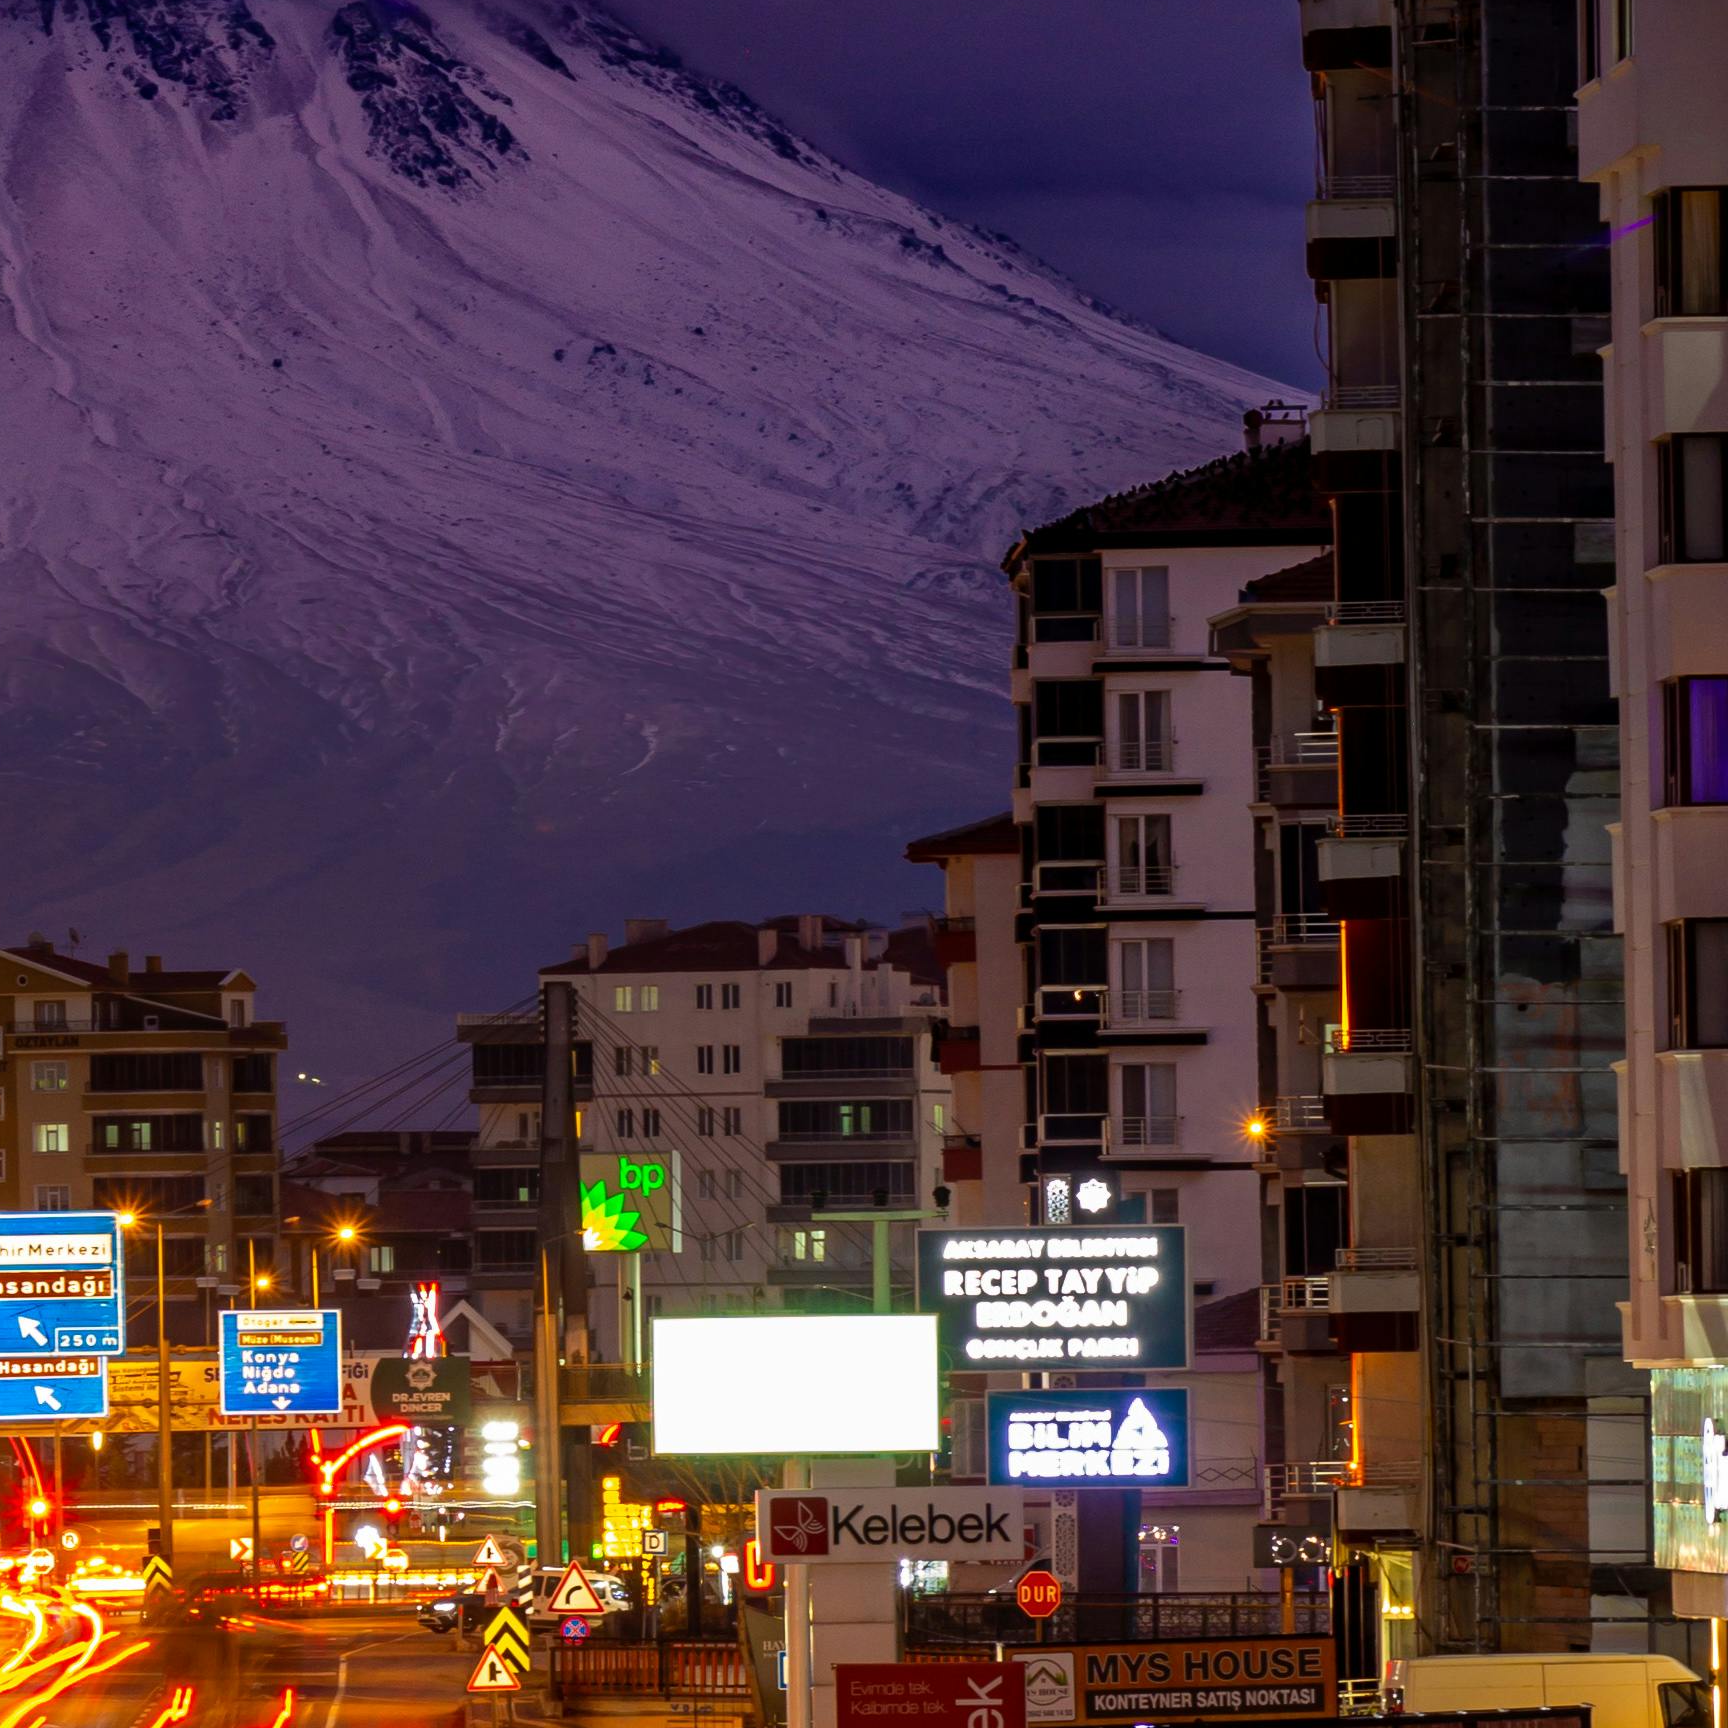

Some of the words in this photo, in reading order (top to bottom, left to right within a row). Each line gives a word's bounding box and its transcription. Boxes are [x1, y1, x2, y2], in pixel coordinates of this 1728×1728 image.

[618, 1156, 665, 1198] bp
[28, 1243, 107, 1257] Merkezi
[944, 1269, 1039, 1297] RECEP
[976, 1296, 1128, 1328] ERDOĞAN
[60, 1334, 97, 1347] 250
[101, 1335, 118, 1347] m
[241, 1350, 300, 1366] Konya
[242, 1365, 296, 1381] Niğde
[243, 1381, 301, 1394] Adana
[832, 1503, 1011, 1545] Kelebek
[649, 1535, 661, 1549] D
[1021, 1586, 1057, 1602] DUR
[1086, 1652, 1171, 1685] MYS
[1184, 1647, 1322, 1681] HOUSE
[850, 1681, 905, 1697] Evimde
[909, 1682, 935, 1696] tek.
[1094, 1692, 1193, 1711] KONTEYNER
[1196, 1690, 1242, 1711] SATIŞ
[1245, 1688, 1316, 1707] NOKTASI
[850, 1701, 920, 1716] Kalbimde
[923, 1700, 948, 1714] tek.
